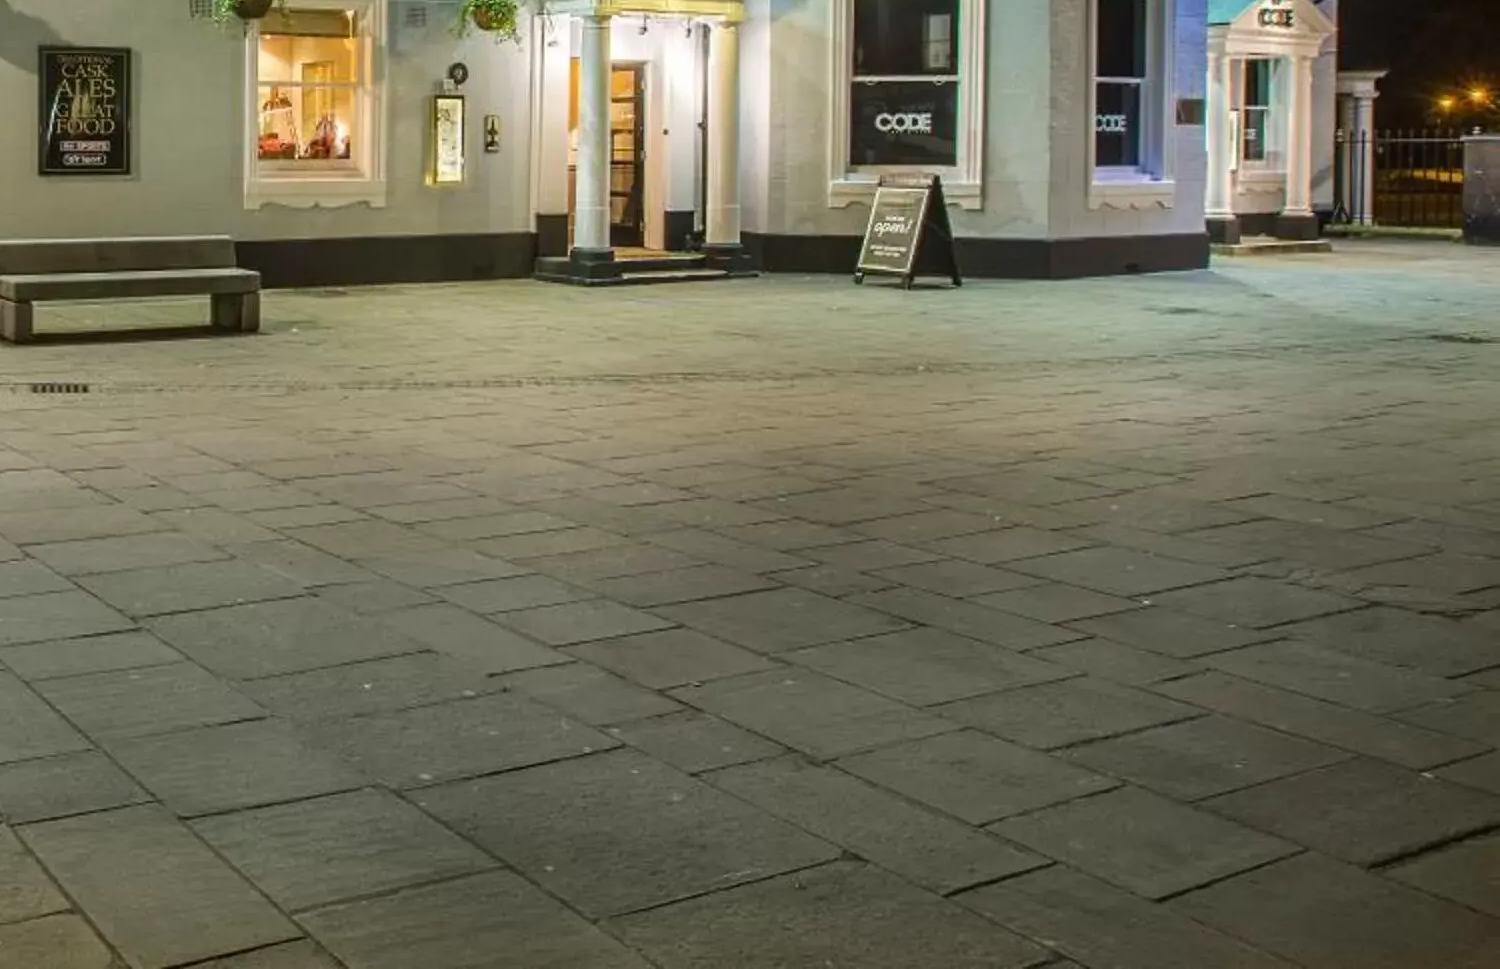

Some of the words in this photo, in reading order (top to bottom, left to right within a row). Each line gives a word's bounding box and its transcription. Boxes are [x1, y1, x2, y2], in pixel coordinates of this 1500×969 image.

[61, 64, 108, 78] CASK
[58, 78, 116, 98] ALES
[56, 118, 116, 136] FOOD
[875, 112, 932, 132] CODE
